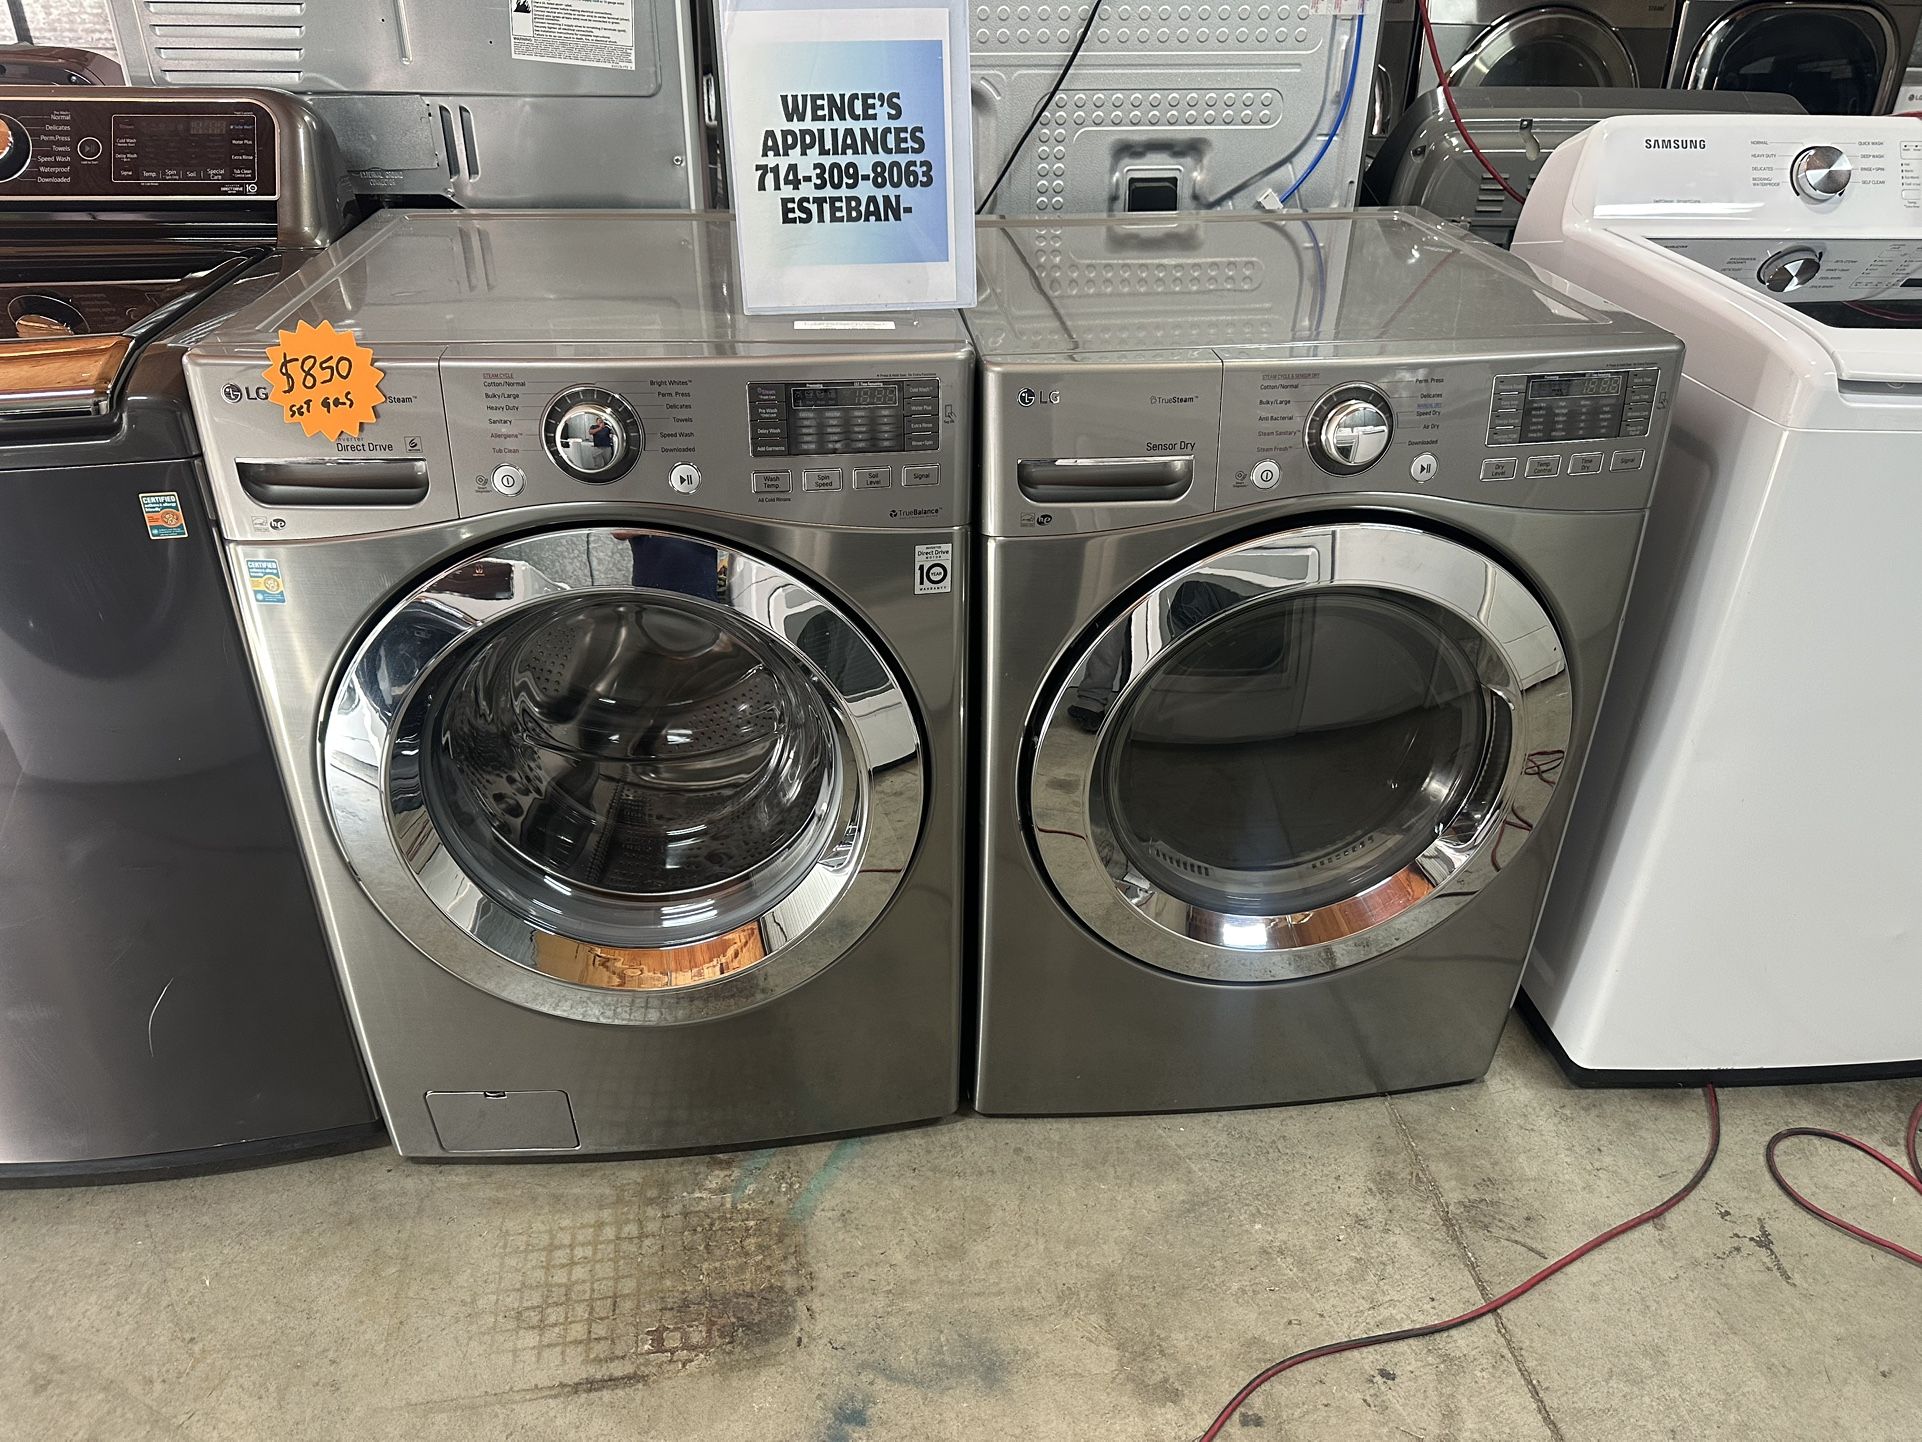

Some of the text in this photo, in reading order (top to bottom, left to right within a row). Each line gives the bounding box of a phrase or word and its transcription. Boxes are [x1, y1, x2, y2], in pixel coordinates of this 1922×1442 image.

[761, 126, 925, 157] APPLIANCES
[1645, 139, 1706, 150] SAMSUNG
[37, 156, 54, 164] Speed
[39, 166, 71, 174] Waterproof
[207, 168, 225, 176] Special
[755, 160, 933, 191] 714-309-8063
[780, 195, 912, 223] ESTEBAN-
[280, 352, 352, 394] $850
[246, 386, 269, 401] LG
[1039, 391, 1061, 404] LG
[321, 391, 354, 414] gas
[336, 442, 394, 452] Direct Drive
[1146, 441, 1196, 451] Sensor Dry
[247, 561, 277, 569] CERTIFIED
[918, 562, 948, 586] 10
